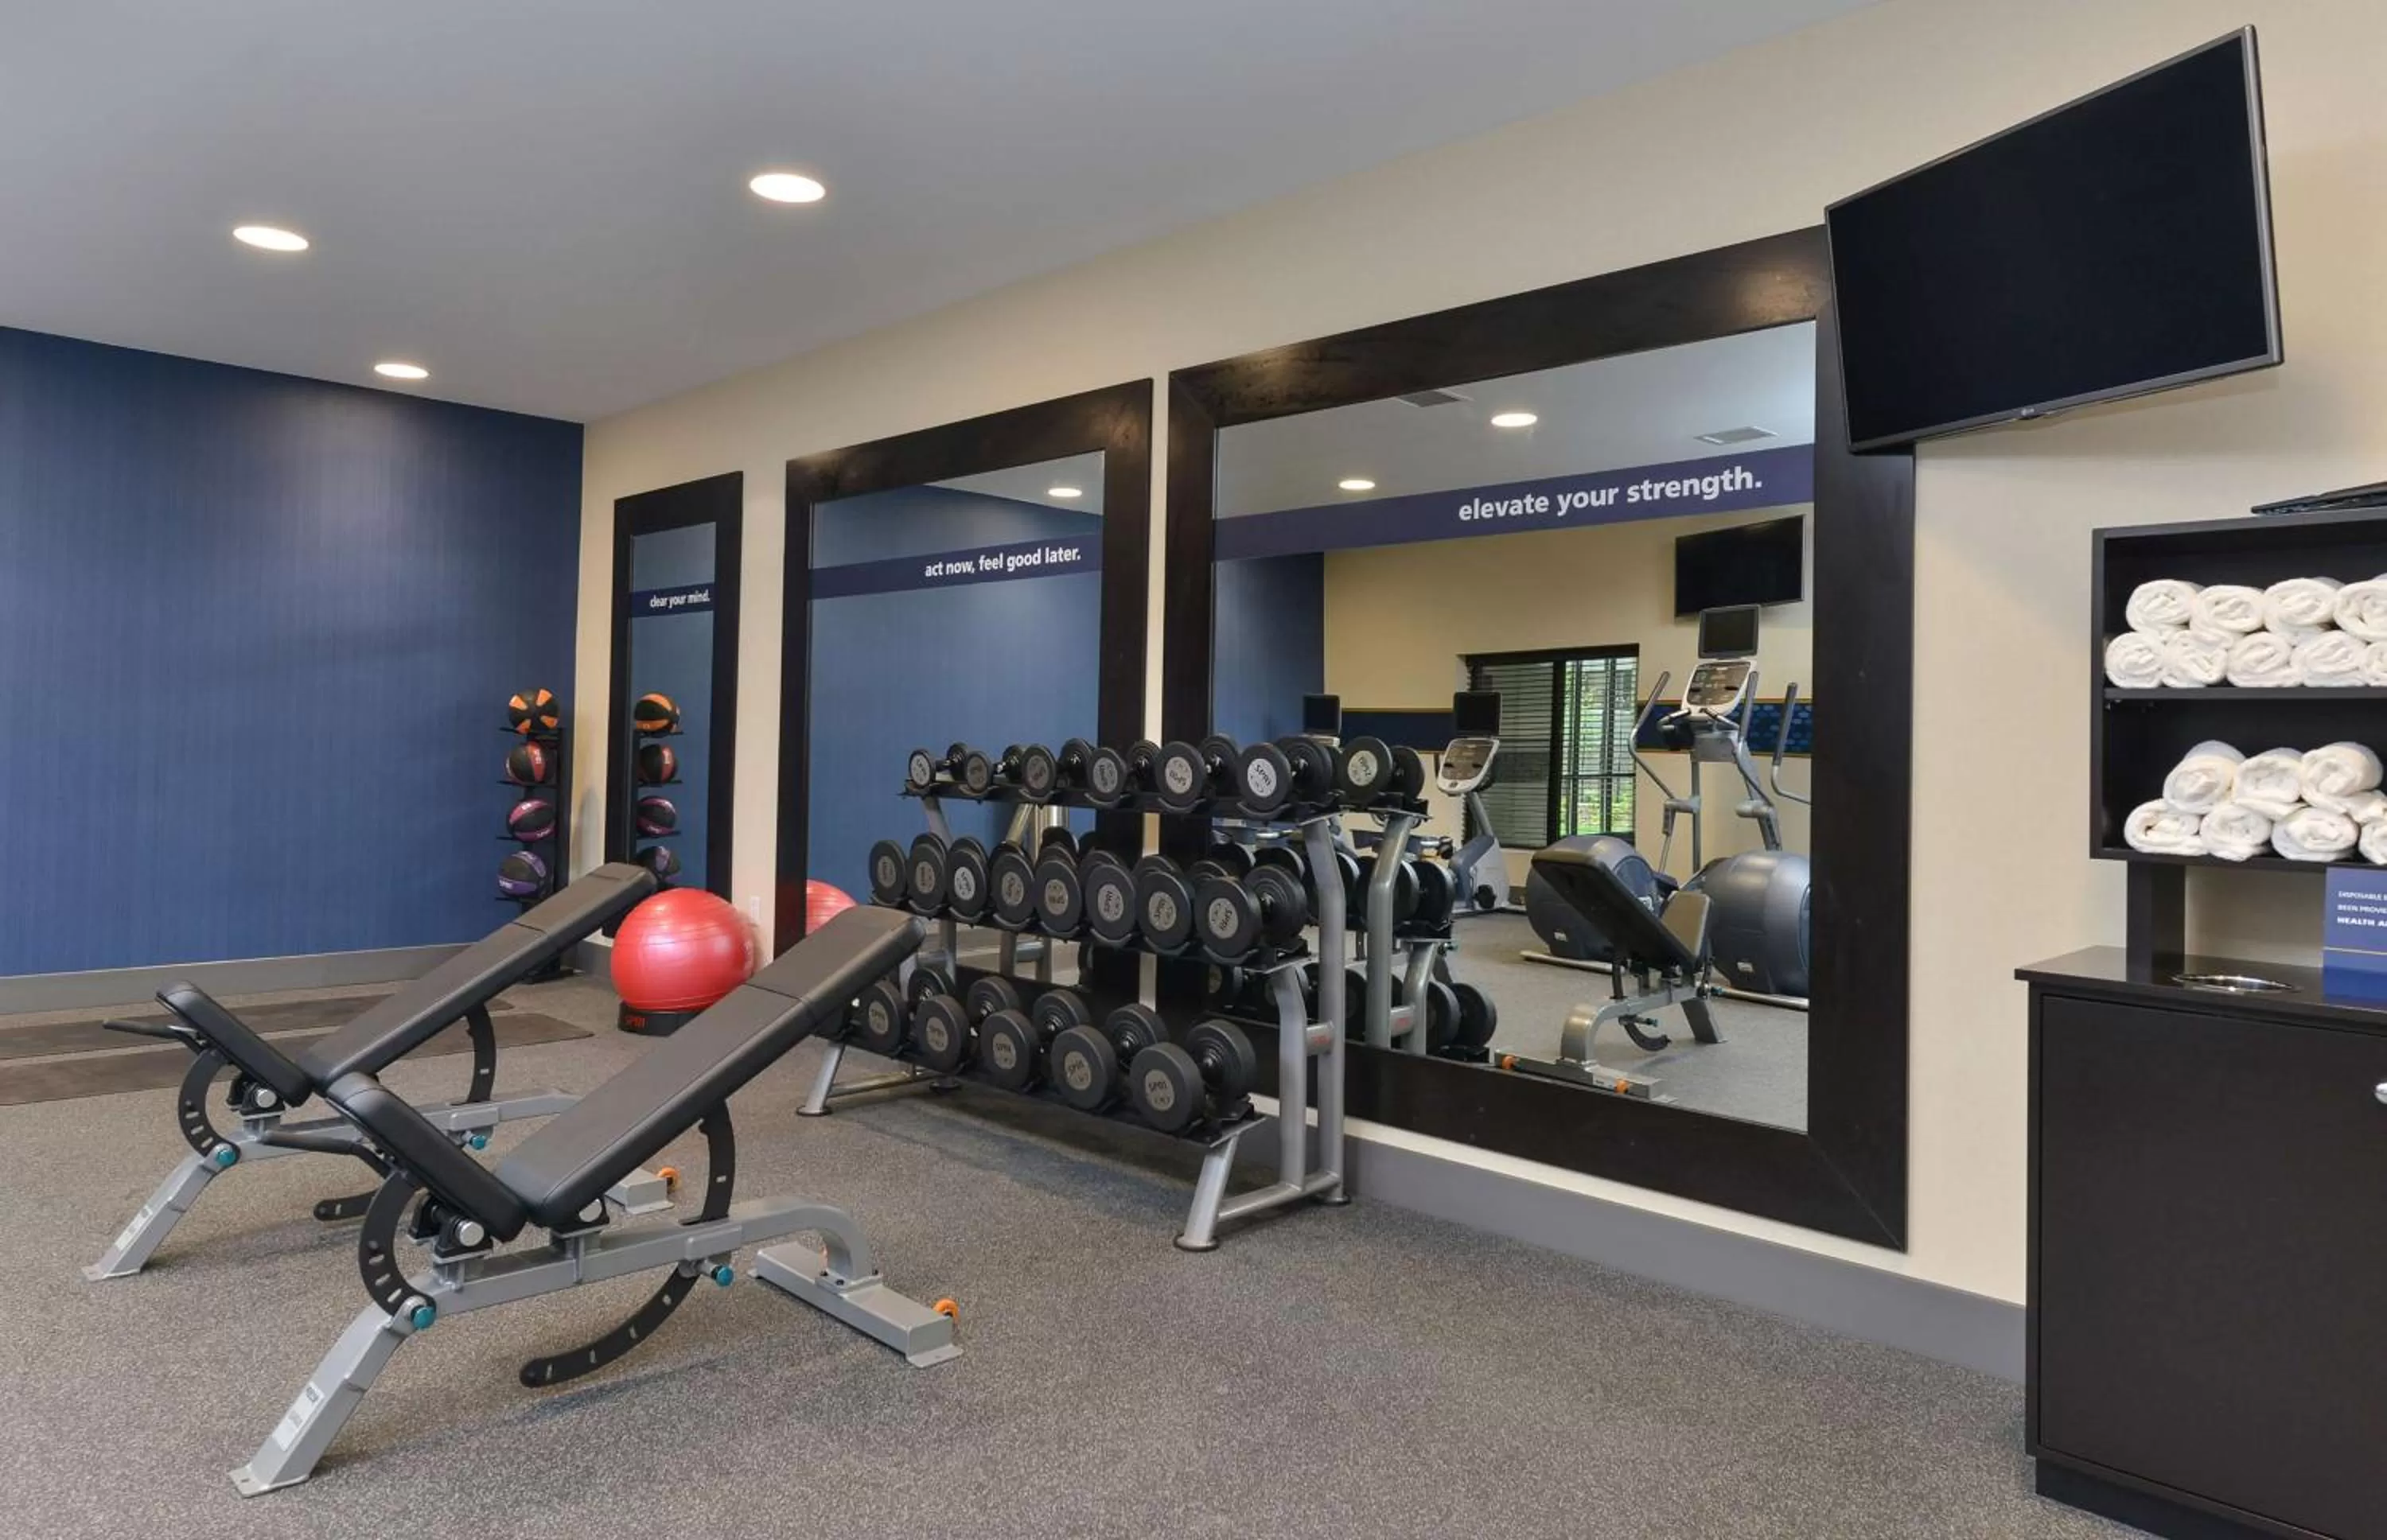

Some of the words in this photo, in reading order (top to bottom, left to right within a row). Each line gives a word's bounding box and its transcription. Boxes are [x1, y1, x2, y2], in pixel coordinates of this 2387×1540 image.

[1458, 492, 1550, 521] elevate
[1556, 486, 1619, 516] your
[1626, 466, 1762, 504] strength.
[925, 562, 944, 577] act
[946, 560, 975, 574] now,
[979, 553, 1003, 571] feel
[1007, 548, 1041, 572] good
[1045, 546, 1081, 564] later.
[668, 594, 687, 609] your
[2337, 916, 2375, 925] HEALTH
